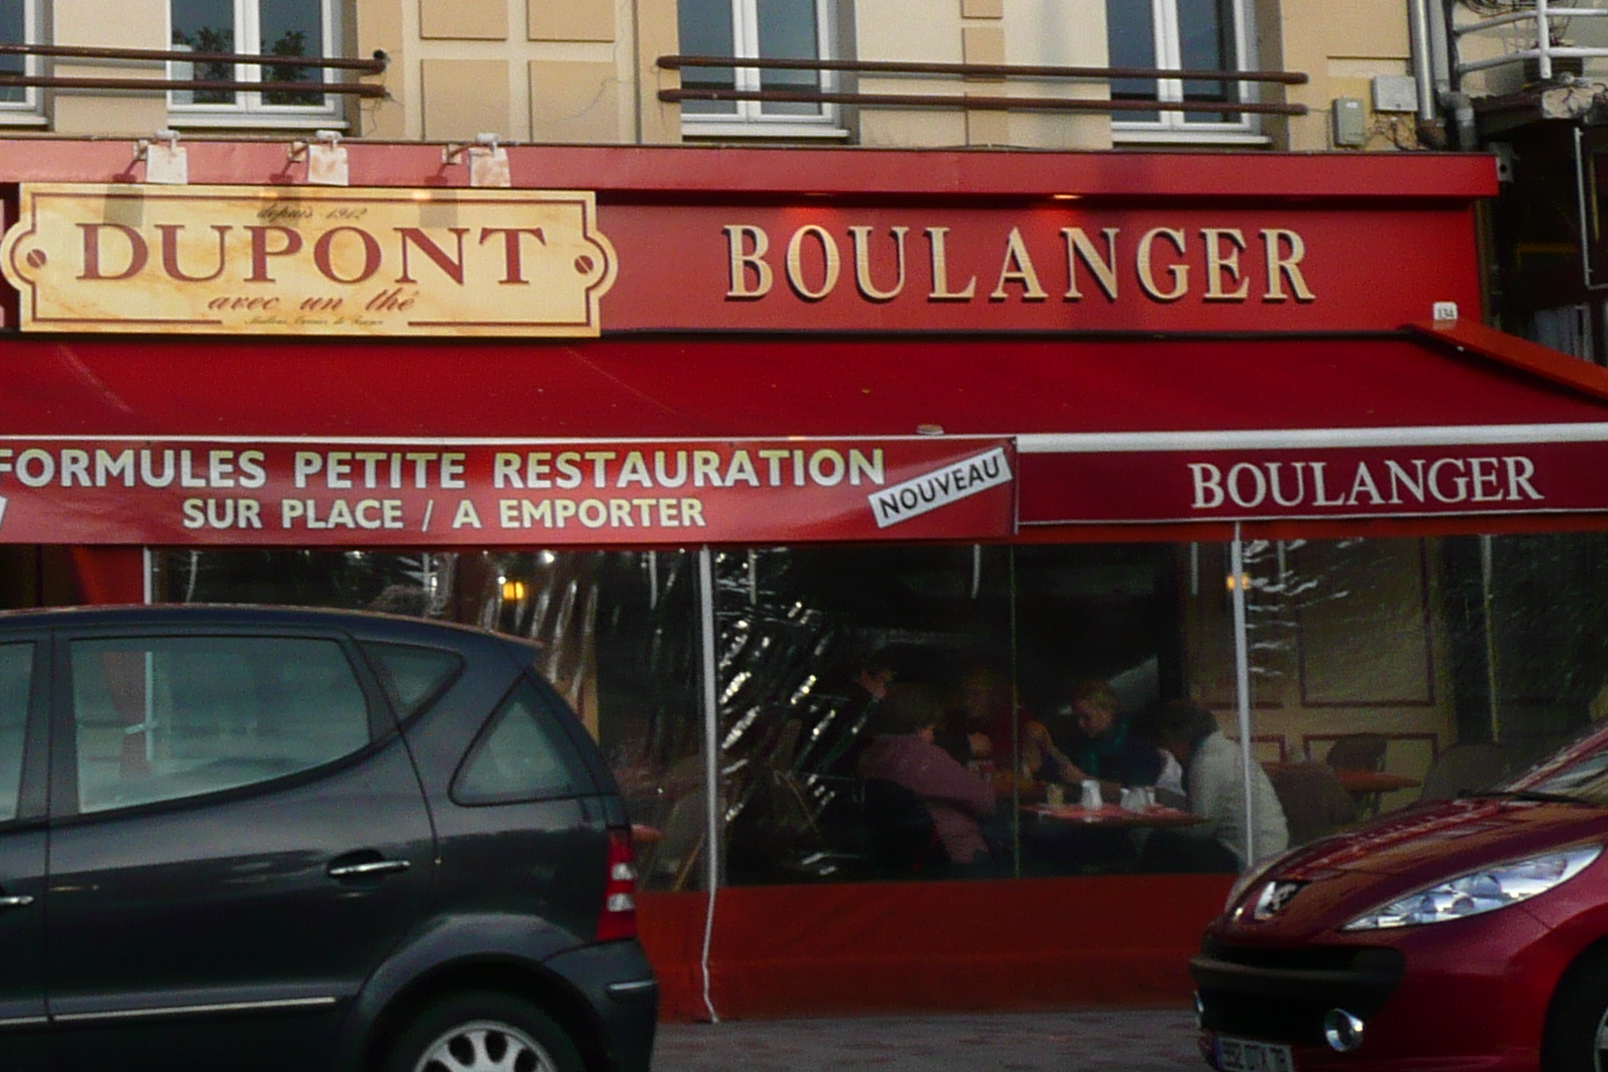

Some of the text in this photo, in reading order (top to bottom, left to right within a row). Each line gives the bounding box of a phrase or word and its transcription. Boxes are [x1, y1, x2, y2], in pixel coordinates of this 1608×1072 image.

[75, 221, 546, 286] DUPONT
[723, 224, 1316, 302] BOULANGER
[207, 286, 420, 312] avec un thé
[294, 451, 467, 489] PETITE
[493, 448, 886, 489] RESTAURATION
[877, 454, 1002, 519] NOUVEAU
[1189, 455, 1545, 509] BOULANGER
[182, 498, 263, 528] SUR
[281, 498, 404, 528] PLACE
[452, 498, 482, 528] A
[499, 497, 707, 528] EMPORTER
